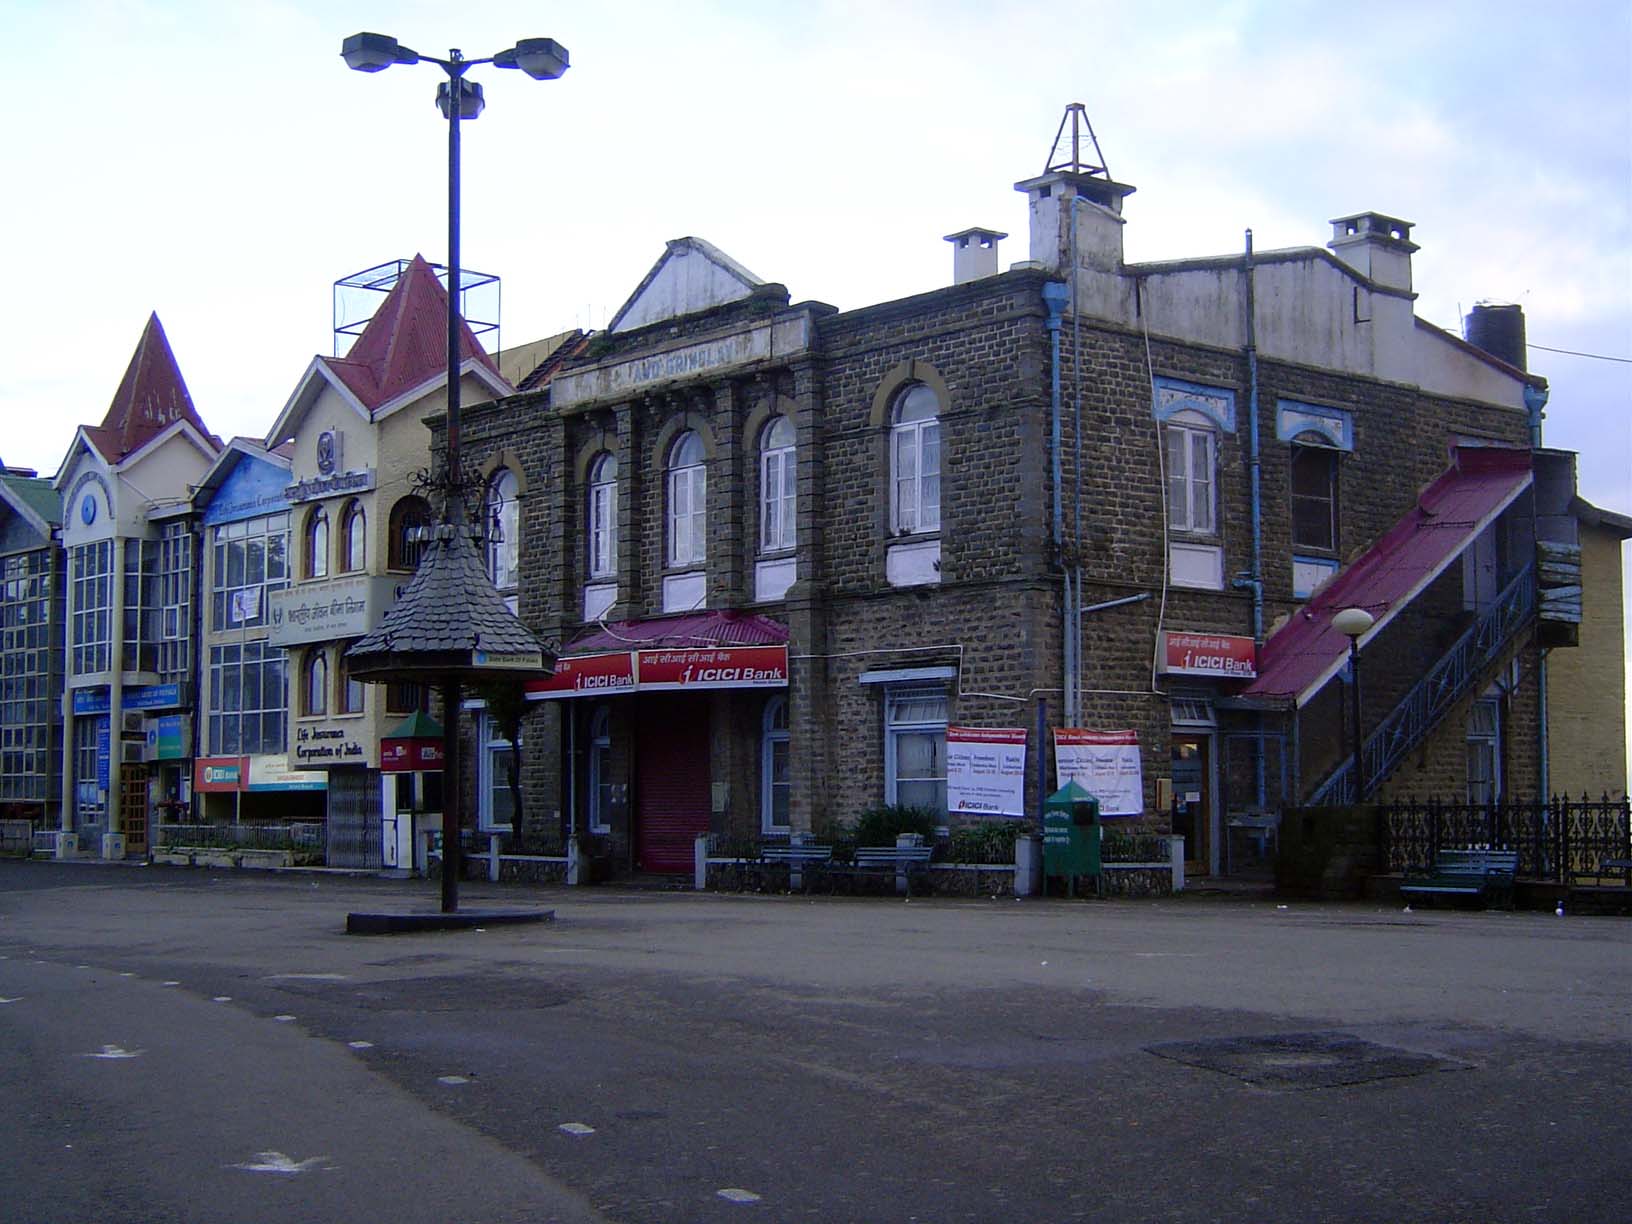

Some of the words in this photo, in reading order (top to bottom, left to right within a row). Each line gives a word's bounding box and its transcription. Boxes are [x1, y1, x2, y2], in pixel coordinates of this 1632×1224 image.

[1194, 656, 1224, 669] ICICI
[1225, 658, 1253, 671] Bank
[584, 675, 608, 688] ICICI
[609, 673, 633, 687] Bank
[697, 668, 741, 681] ICICI
[743, 667, 782, 681] Bank
[297, 728, 308, 743] Life
[297, 745, 333, 762] Corporation
[335, 743, 343, 759] of
[344, 741, 363, 756] India
